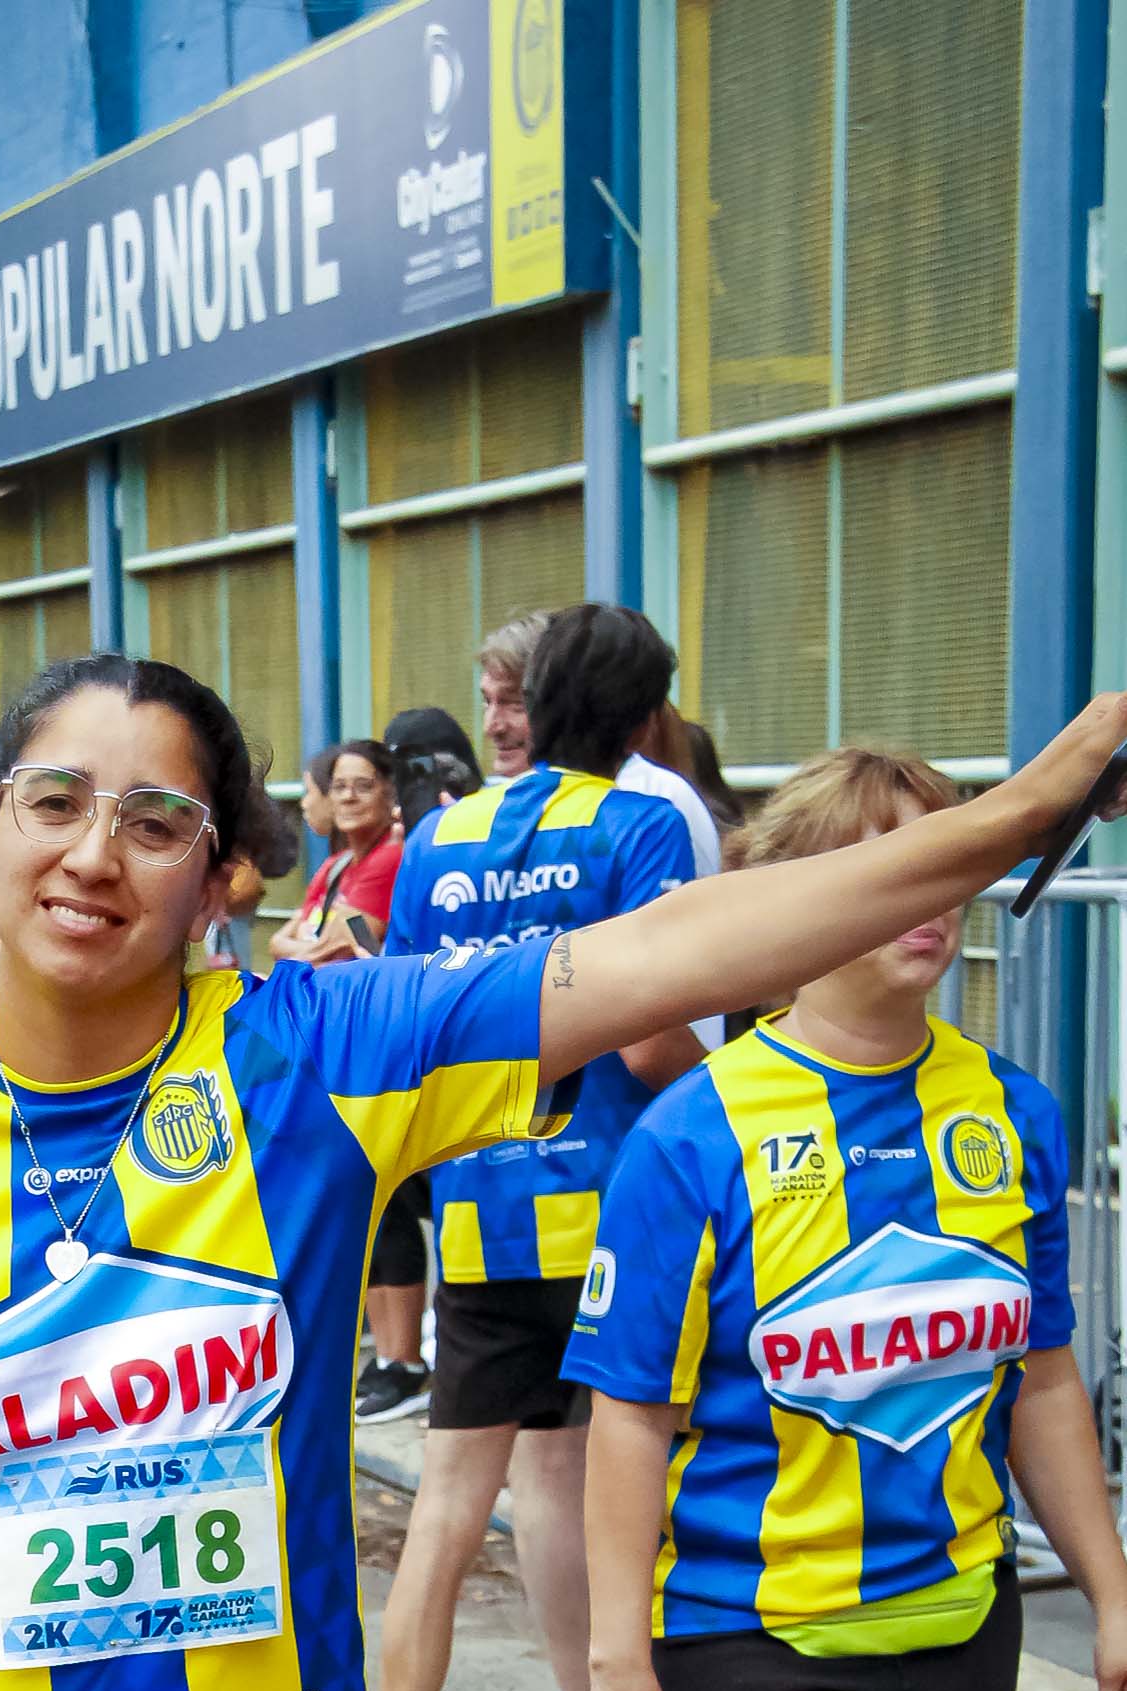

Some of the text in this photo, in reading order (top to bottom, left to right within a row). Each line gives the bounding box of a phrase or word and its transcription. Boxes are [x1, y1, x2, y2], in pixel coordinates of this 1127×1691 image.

[153, 113, 341, 358] NORTE
[483, 863, 580, 902] Macro
[760, 1131, 818, 1173] 17
[761, 1296, 1031, 1383] PALADINI
[26, 1508, 246, 1605] 2518
[188, 1595, 257, 1612] MARATÓN
[189, 1606, 255, 1623] CANALLA
[23, 1620, 70, 1650] 2K
